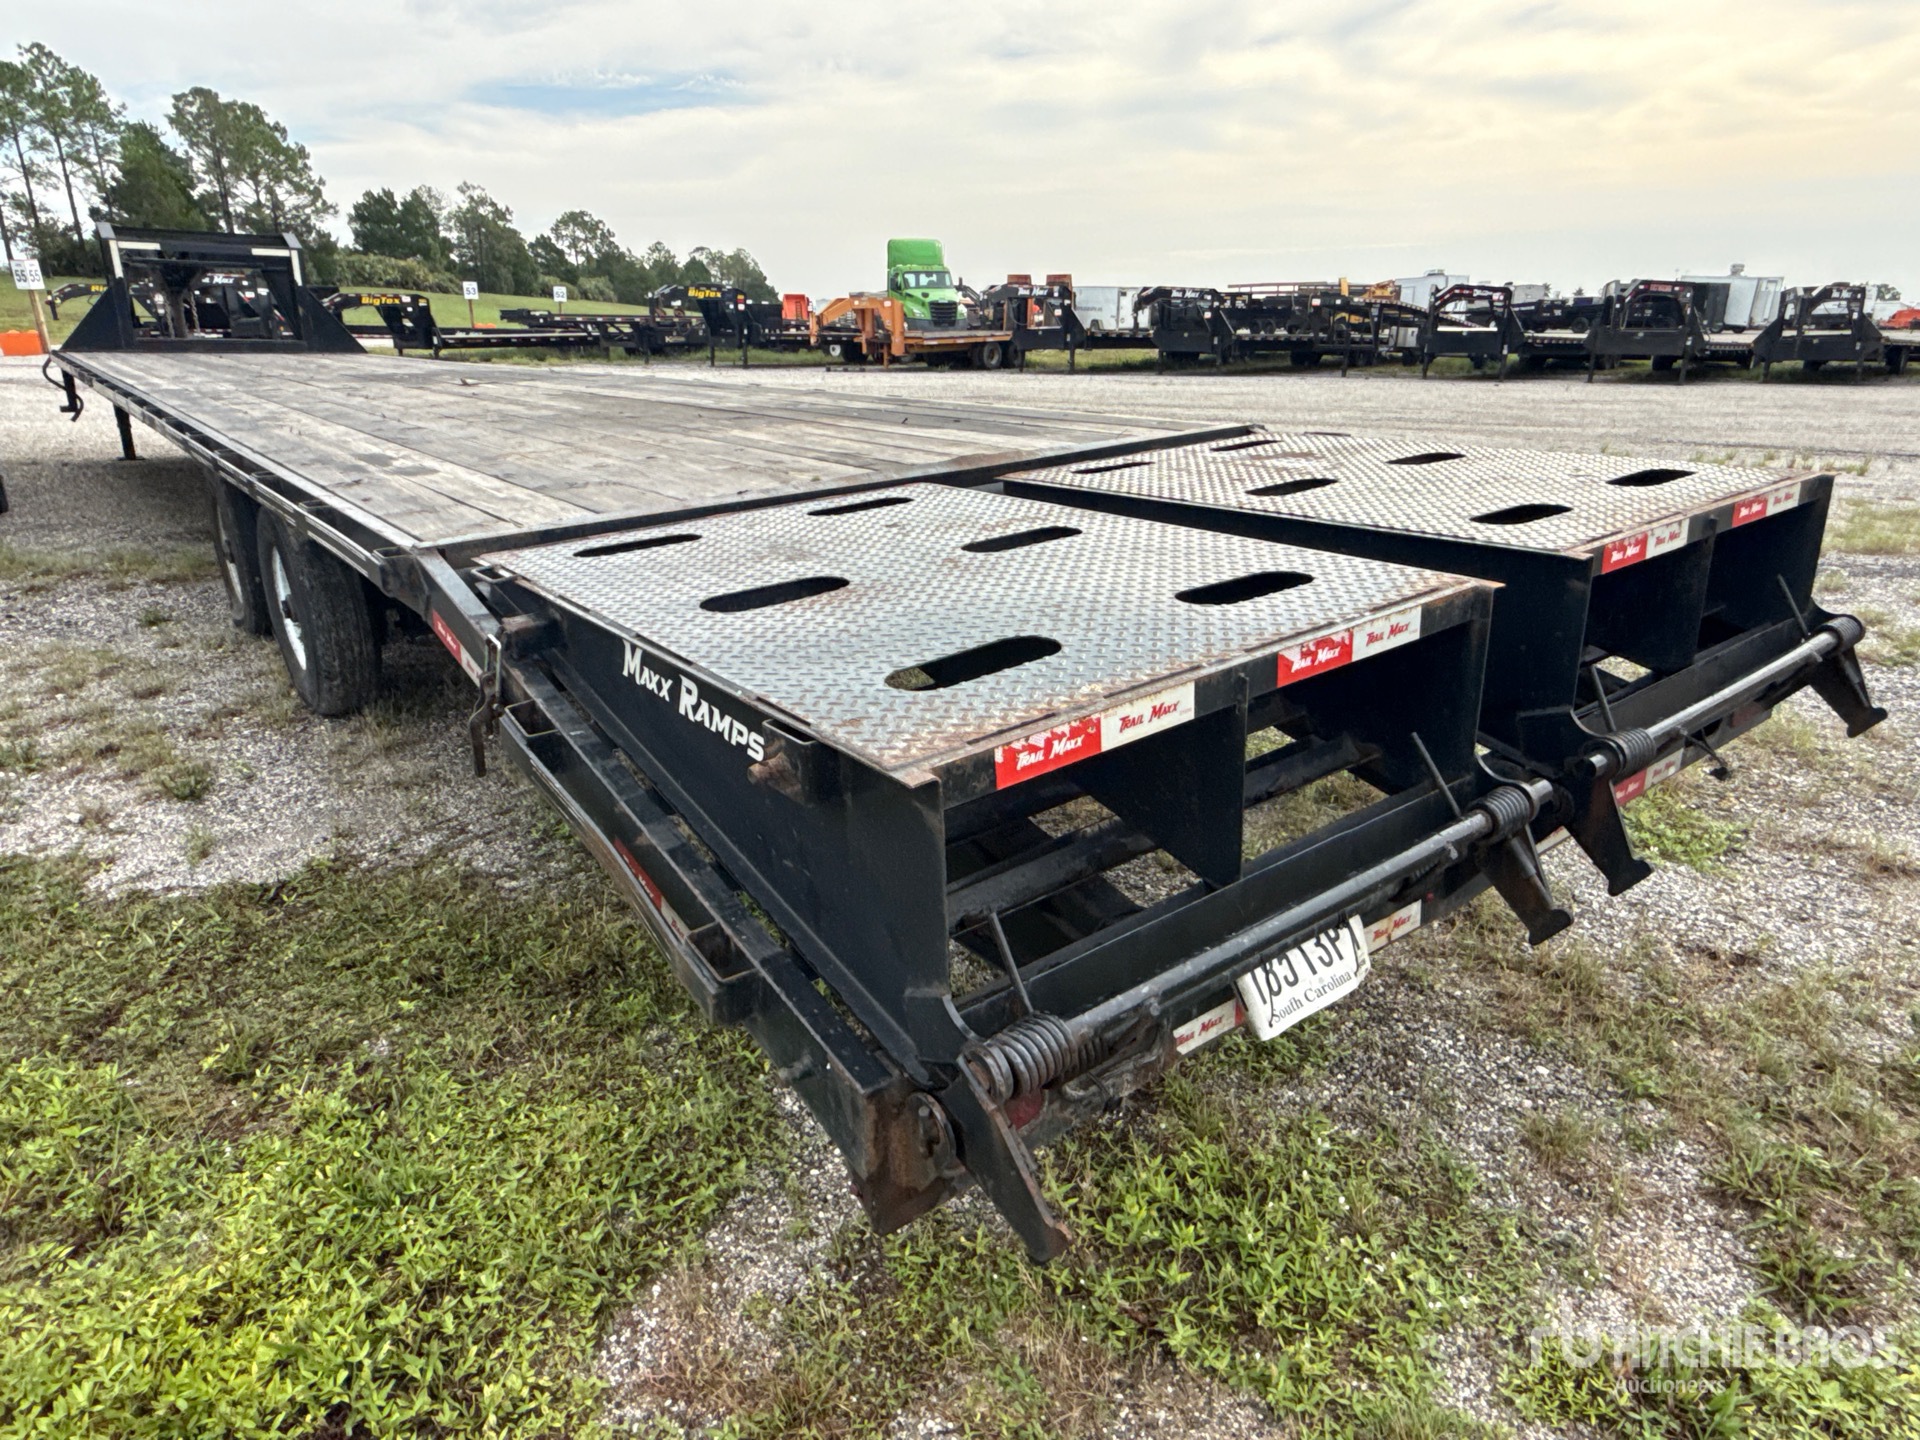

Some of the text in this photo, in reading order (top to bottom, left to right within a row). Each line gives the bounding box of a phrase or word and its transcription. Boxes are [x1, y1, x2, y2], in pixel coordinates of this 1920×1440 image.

[14, 269, 28, 283] 55
[28, 269, 41, 283] 55
[465, 287, 477, 296] 53
[555, 291, 566, 299] 52
[1272, 971, 1353, 1024] South Carolina
